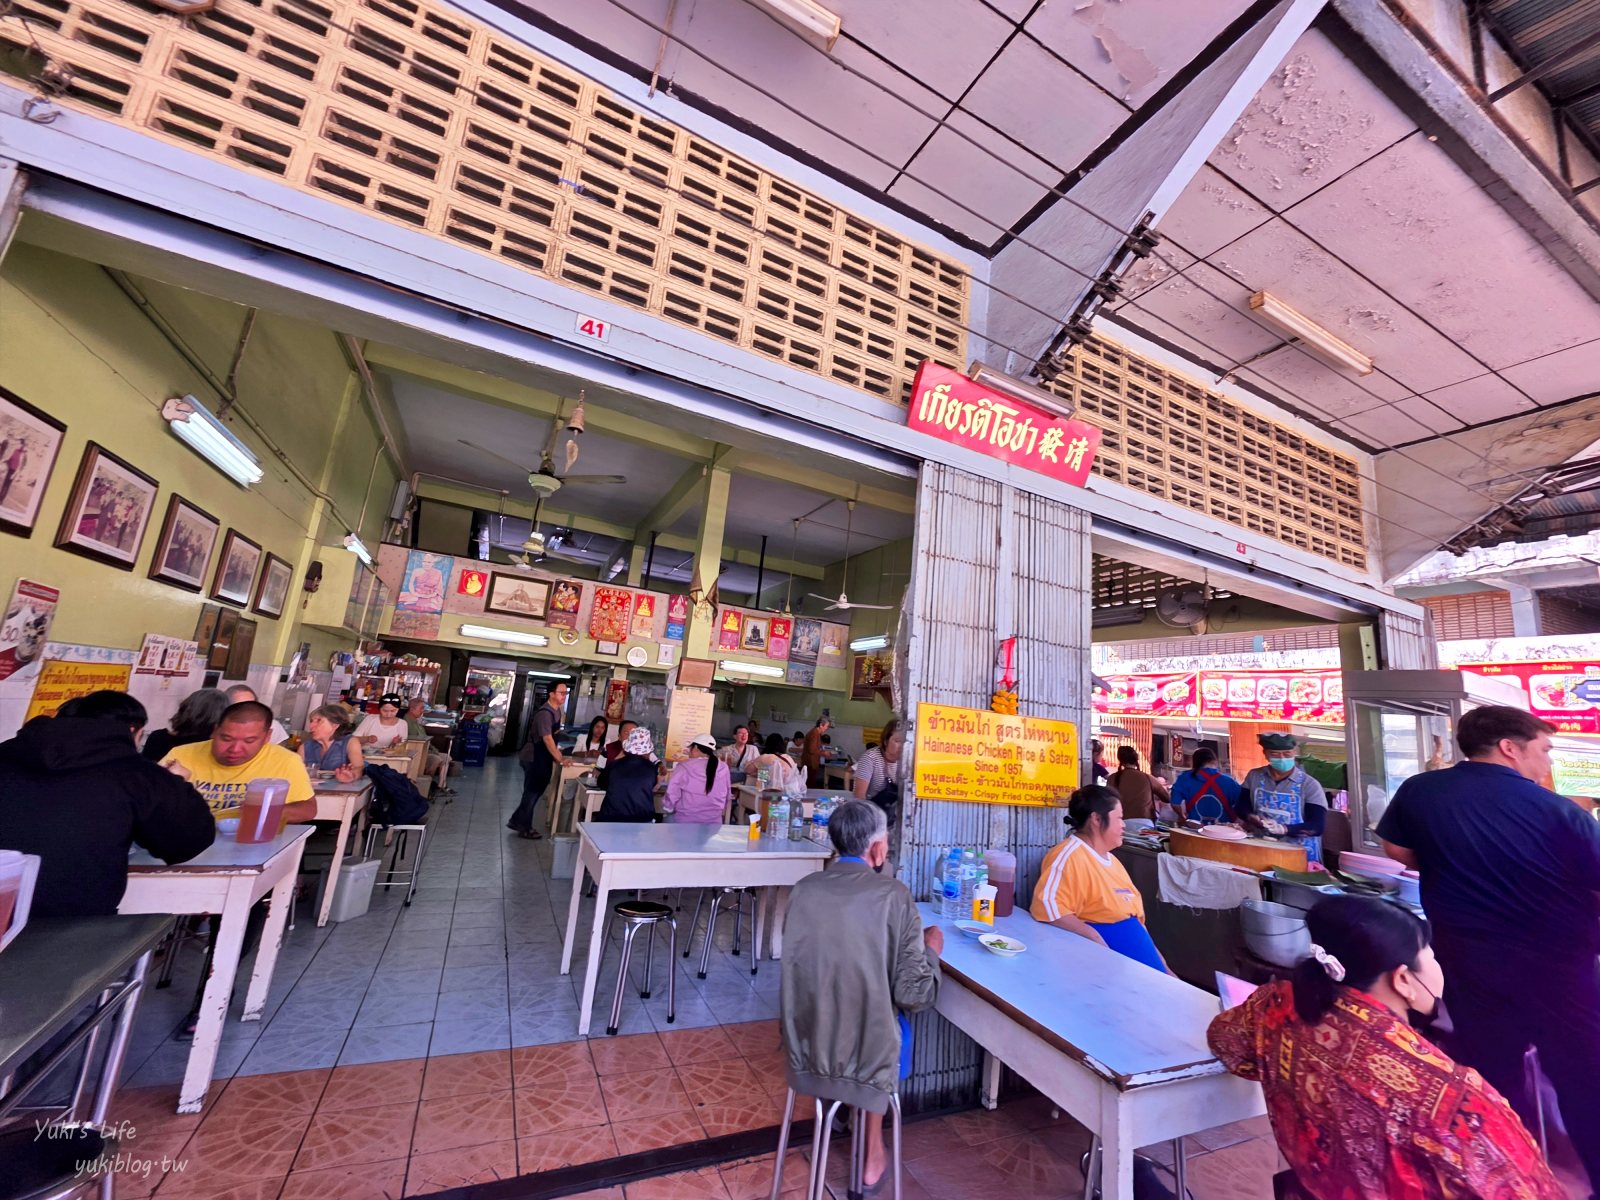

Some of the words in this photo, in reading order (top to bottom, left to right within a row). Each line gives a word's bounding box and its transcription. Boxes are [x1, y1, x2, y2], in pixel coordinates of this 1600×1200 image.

[580, 319, 604, 338] 41
[928, 709, 991, 736] ข้าวมันไก่
[923, 736, 973, 756] Hainanese
[977, 742, 1013, 760] Chicken
[1016, 745, 1036, 762] Rice
[1039, 748, 1046, 763] &
[1049, 749, 1074, 769] Satay
[974, 759, 999, 773] Since
[1003, 763, 1024, 776] 1957
[923, 786, 942, 795] Pork
[945, 787, 968, 798] Satay
[974, 789, 1000, 800] Crispy
[1002, 792, 1022, 801] Fried
